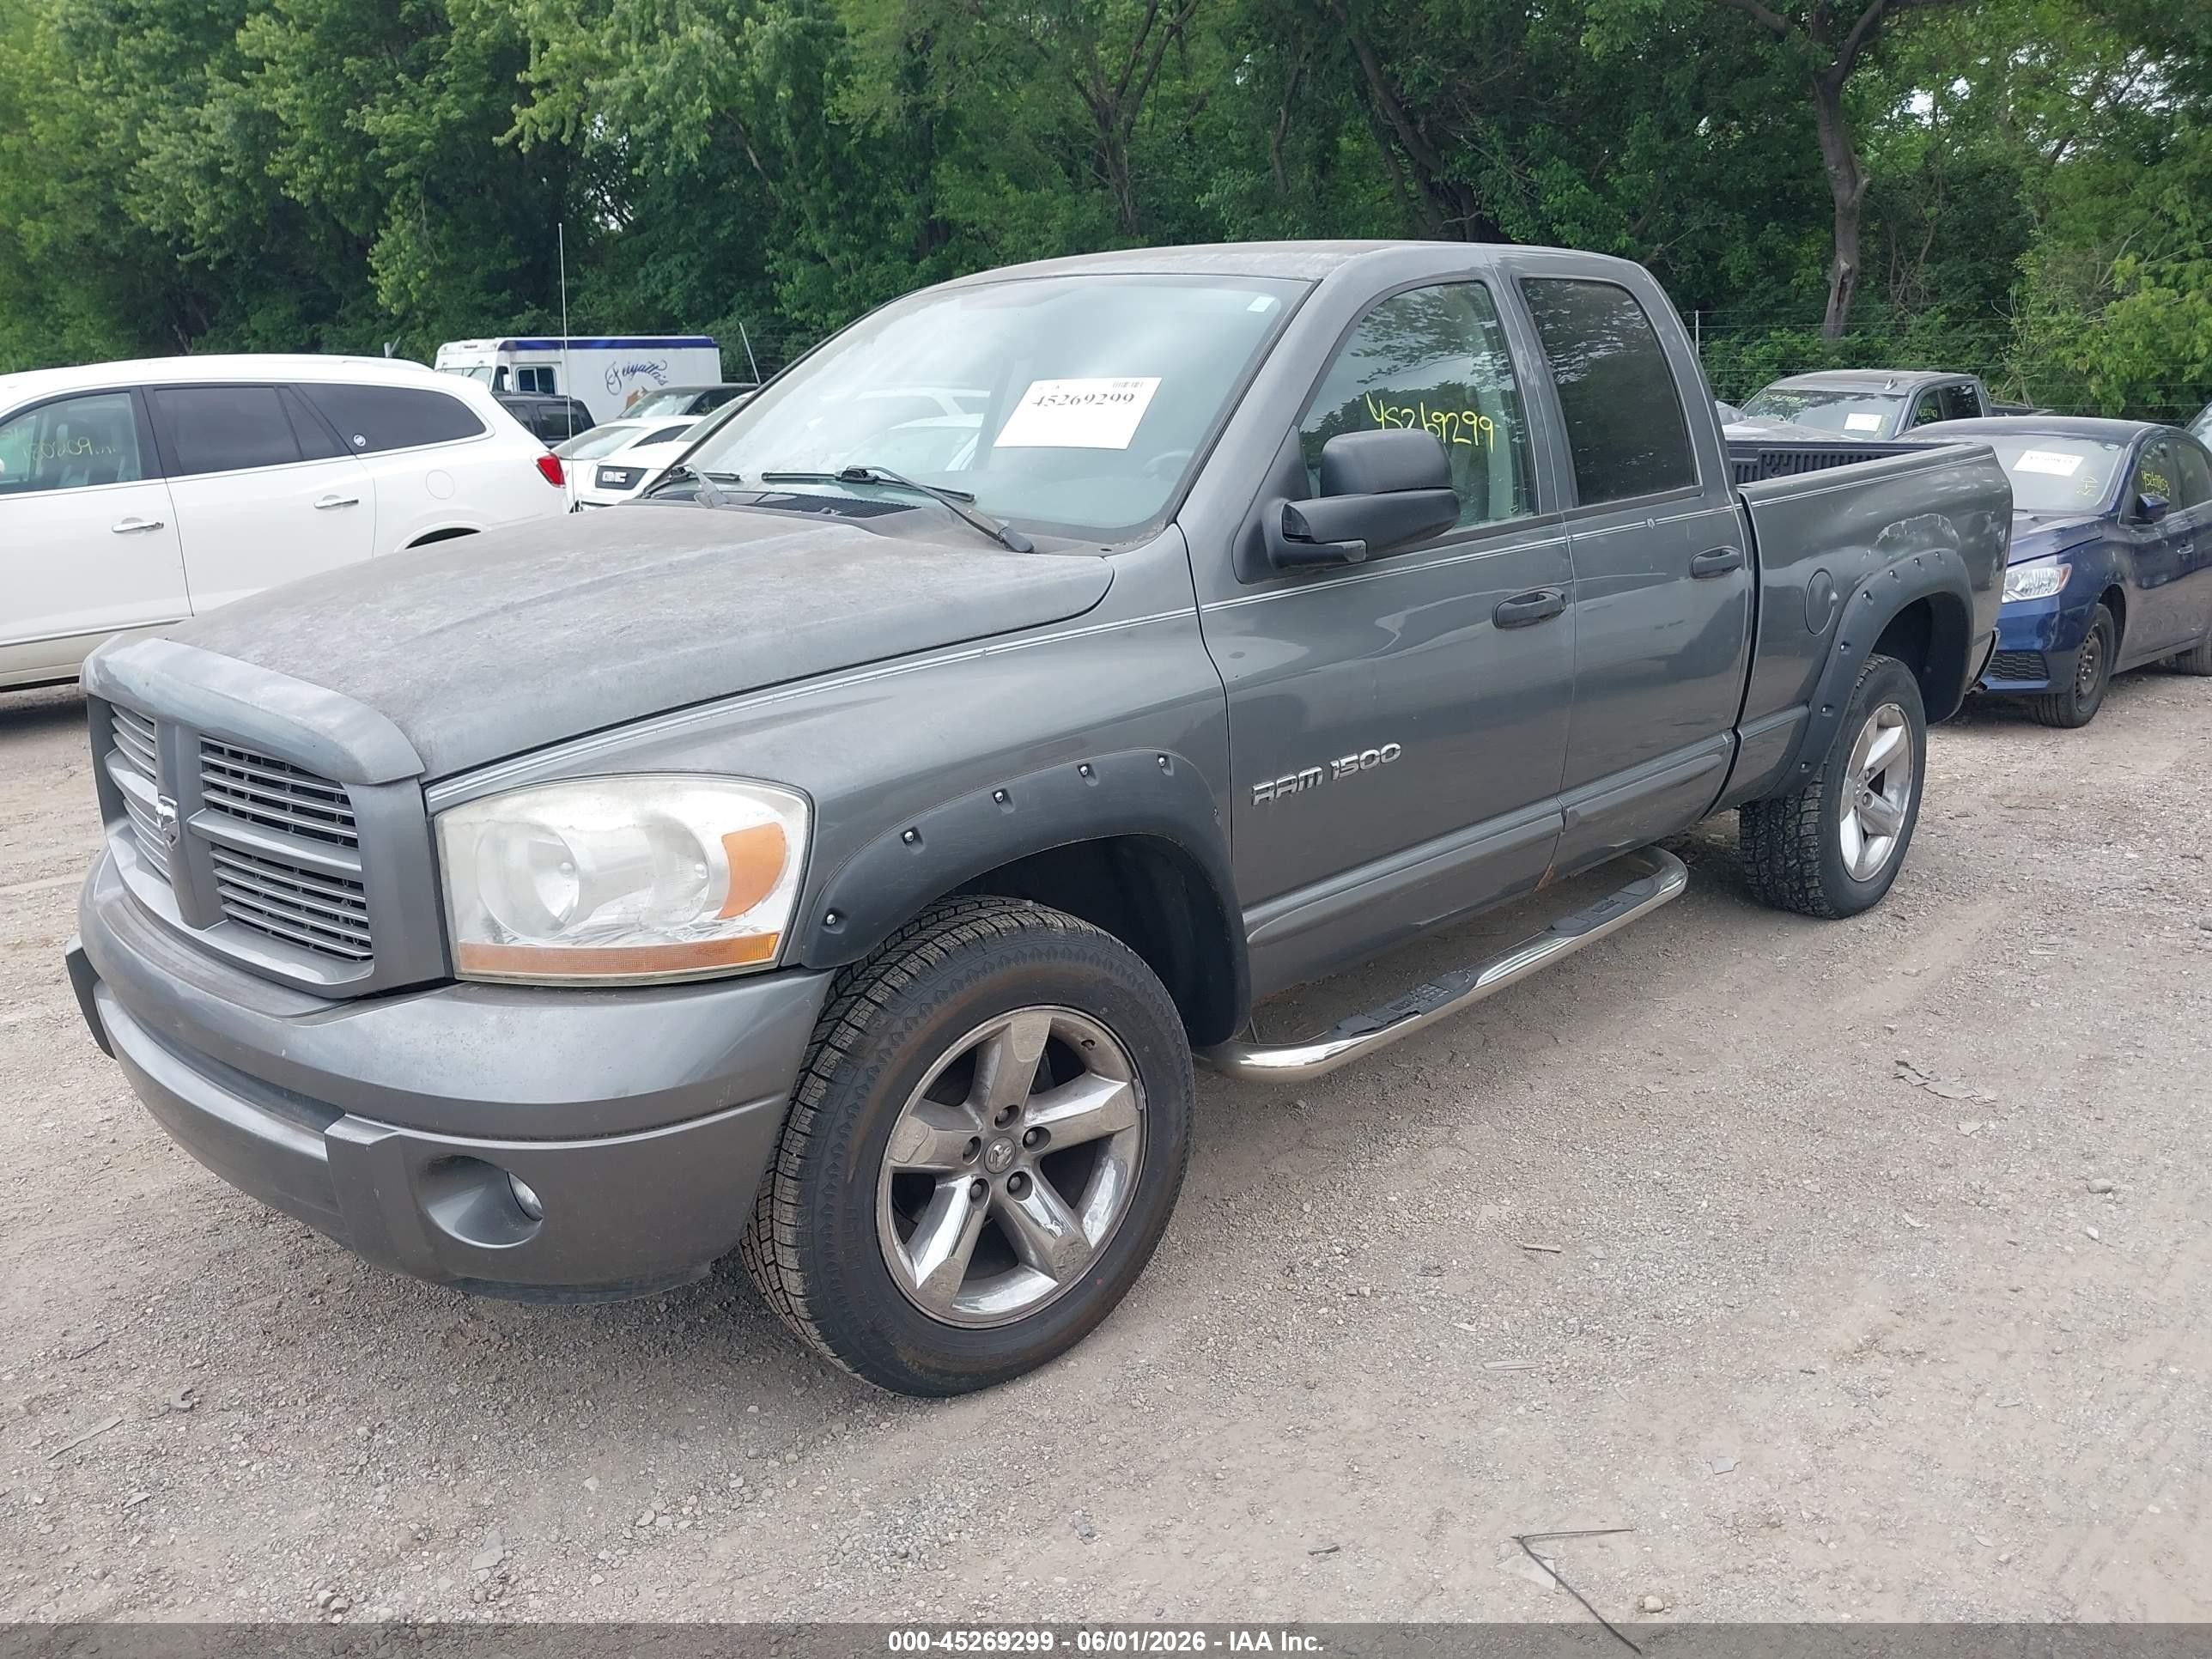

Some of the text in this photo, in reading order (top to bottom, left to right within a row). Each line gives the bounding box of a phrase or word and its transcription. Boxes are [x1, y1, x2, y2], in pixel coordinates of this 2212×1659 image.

[1031, 392, 1135, 407] 45269299
[1365, 392, 1494, 453] 45269299
[1251, 743, 1401, 806] RAM 1500
